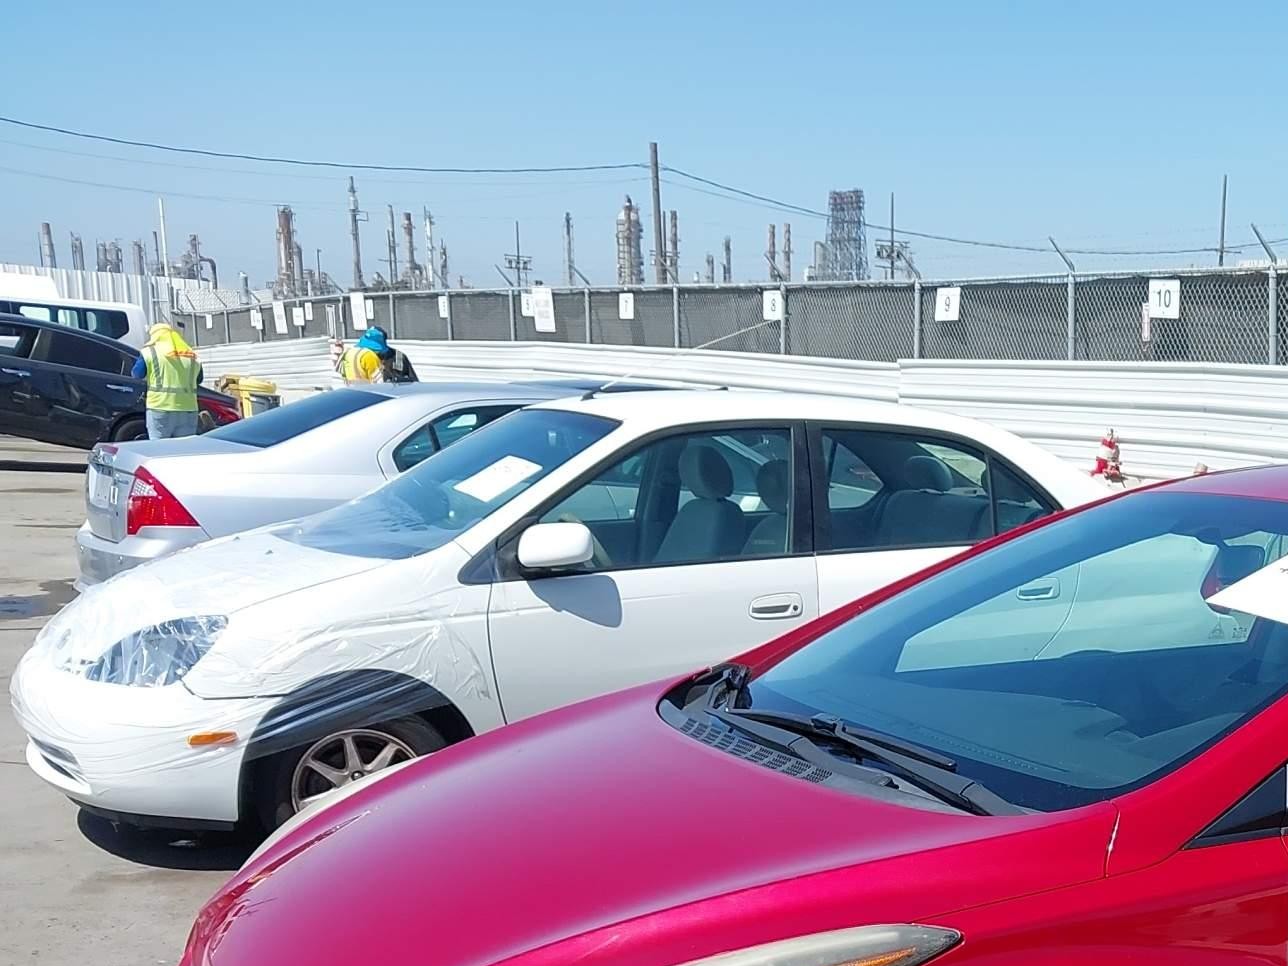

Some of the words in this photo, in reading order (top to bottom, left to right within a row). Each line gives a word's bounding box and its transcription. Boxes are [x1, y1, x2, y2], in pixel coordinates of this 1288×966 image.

[770, 297, 777, 312] 8
[944, 295, 951, 312] 9
[1157, 288, 1171, 308] 10
